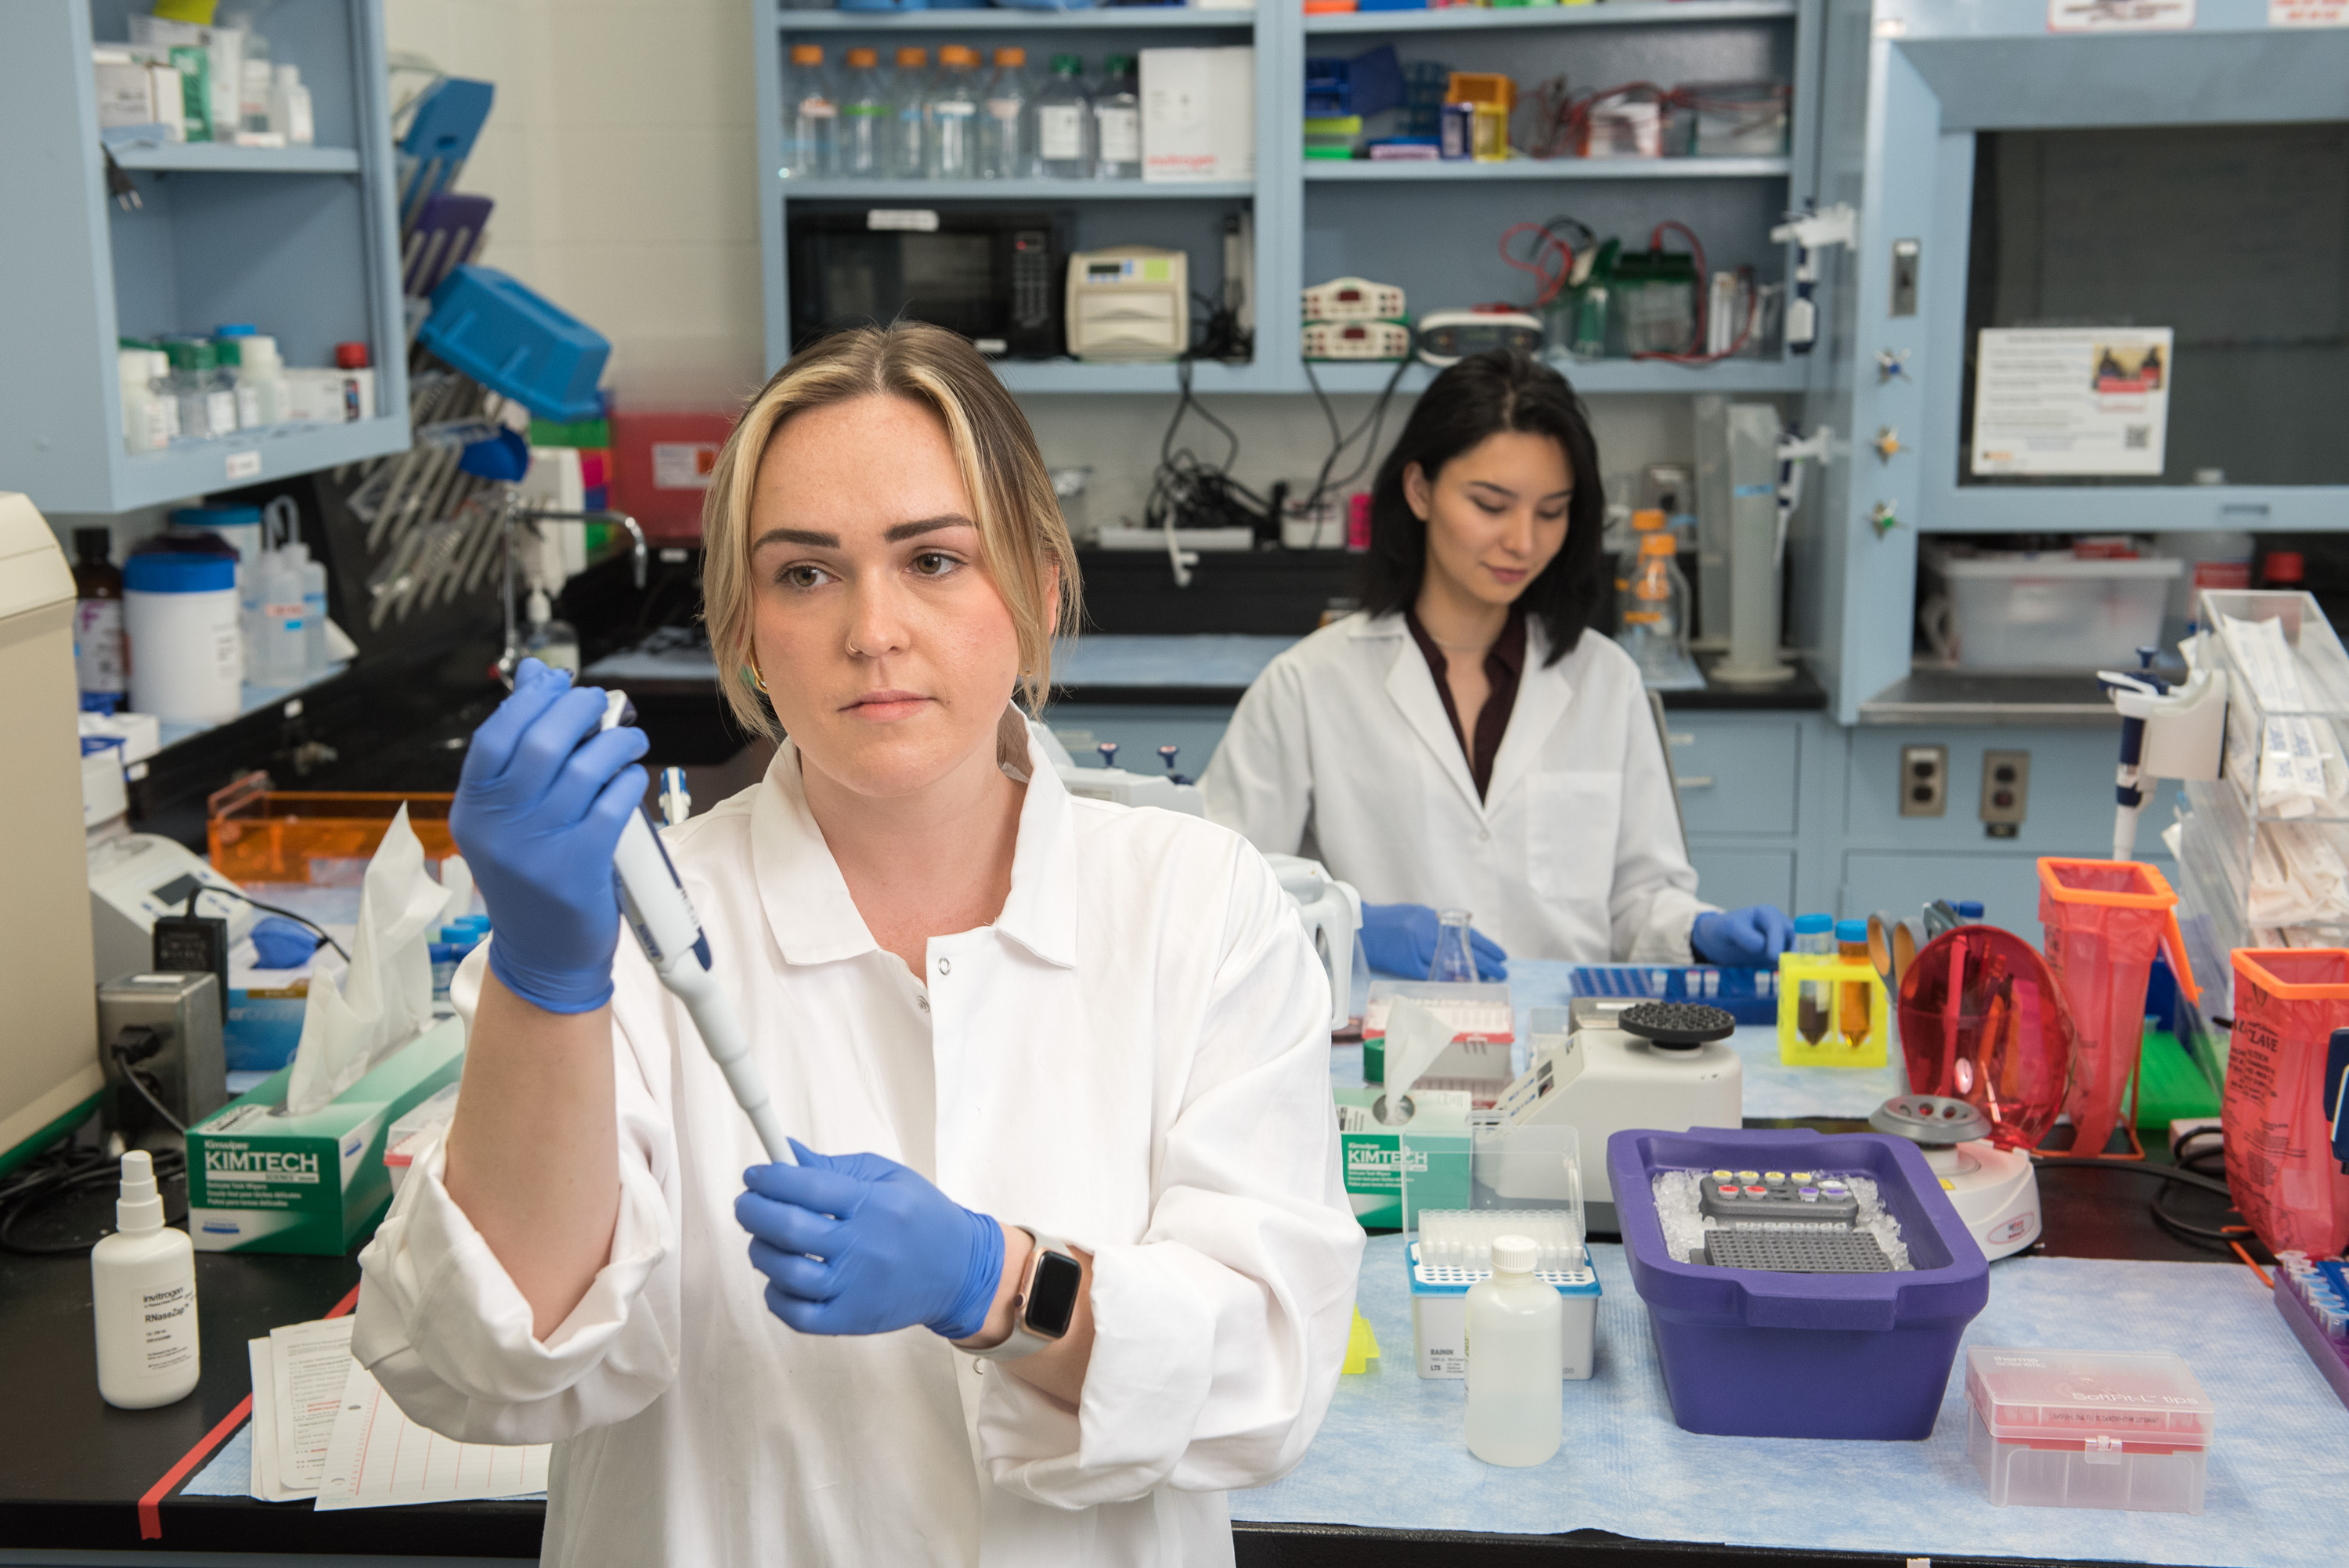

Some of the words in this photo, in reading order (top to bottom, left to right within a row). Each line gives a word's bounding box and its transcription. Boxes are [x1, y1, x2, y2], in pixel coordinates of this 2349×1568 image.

[204, 1140, 249, 1152] Kimwipes
[205, 1151, 318, 1173] KIMTECH
[1348, 1150, 1428, 1166] KIMTECH
[143, 1287, 183, 1303] invitrogen
[2163, 1396, 2199, 1405] tips
